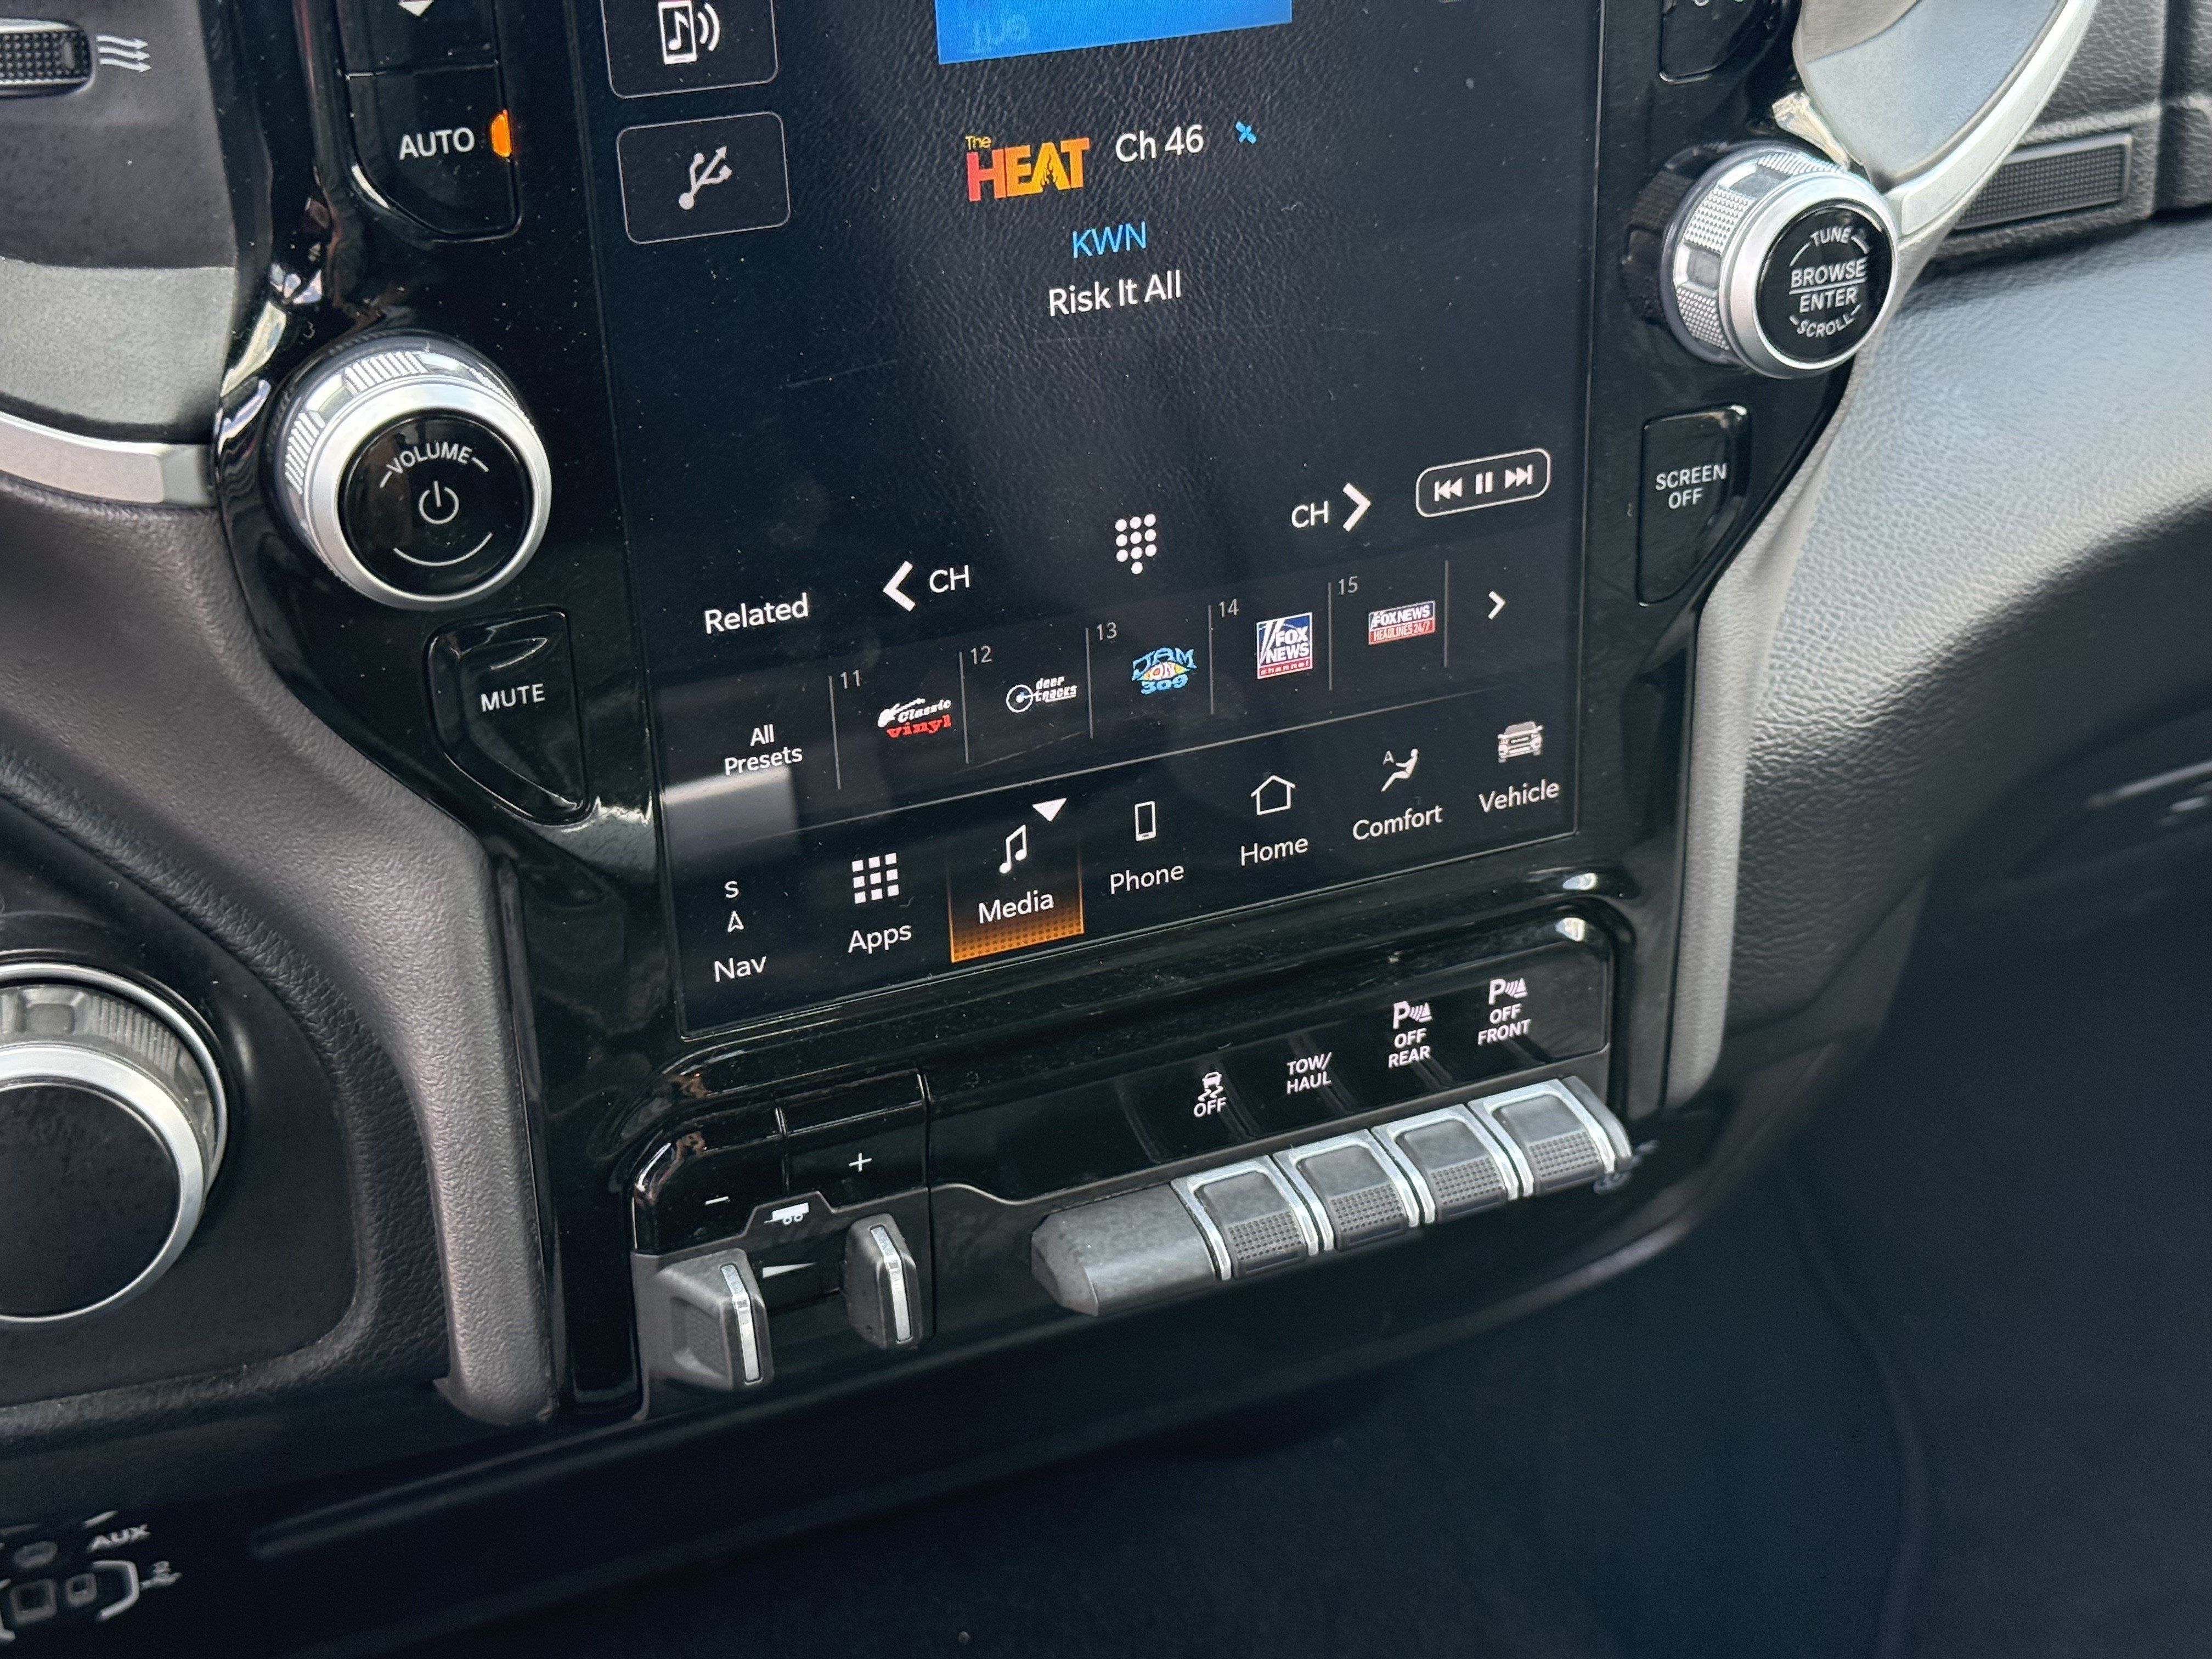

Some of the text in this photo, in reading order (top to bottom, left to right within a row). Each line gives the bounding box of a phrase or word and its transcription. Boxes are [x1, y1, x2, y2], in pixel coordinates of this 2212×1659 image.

[399, 127, 475, 160] AUTO
[964, 135, 992, 150] The
[1115, 123, 1205, 163] Ch 46
[966, 137, 1090, 202] HEAT
[1071, 220, 1147, 259] KWN
[1810, 225, 1853, 247] TUNE
[1790, 258, 1867, 287] BROWSE
[1048, 269, 1182, 318] Risk It All
[1798, 287, 1858, 313] ENTER
[1797, 314, 1854, 338] SCROLL
[386, 442, 473, 475] VOLUME
[1655, 462, 1728, 491] SCREEN
[1668, 486, 1704, 510] OFF
[1291, 500, 1329, 529] CH
[929, 564, 970, 594] CH
[1338, 575, 1358, 595] 15
[704, 591, 809, 635] Related
[1218, 598, 1239, 618] 14
[1096, 621, 1118, 641] 13
[1275, 626, 1309, 647] FOX
[1373, 624, 1413, 642] HEADLINES
[970, 645, 993, 665] 12
[1131, 647, 1198, 681] JAM
[1266, 642, 1311, 664] NEWS
[840, 669, 861, 690] 11
[1260, 658, 1310, 676] channel
[480, 682, 546, 712] MUTE
[1140, 674, 1189, 696] 309
[898, 699, 952, 724] Classic
[749, 723, 775, 747] All
[887, 714, 951, 738] vinyl
[723, 746, 804, 776] Presets
[1478, 778, 1560, 813] Vehicle
[1352, 805, 1443, 840] Comfort
[1240, 837, 1309, 867] Home
[724, 880, 740, 899] S
[1110, 865, 1184, 895] Phone
[978, 889, 1054, 924] Media
[847, 924, 912, 955] Apps
[714, 955, 767, 983] Nav
[1488, 978, 1505, 1005] P
[1392, 1001, 1410, 1029] P
[1489, 1003, 1521, 1025] OFF
[1393, 1028, 1427, 1049] OFF
[1477, 1018, 1532, 1046] FRONT
[1286, 1051, 1333, 1076] TOW/
[1387, 1045, 1431, 1069] REAR
[1286, 1071, 1332, 1094] HAUL
[1193, 1096, 1227, 1118] OFF
[88, 1523, 151, 1552] AUX
